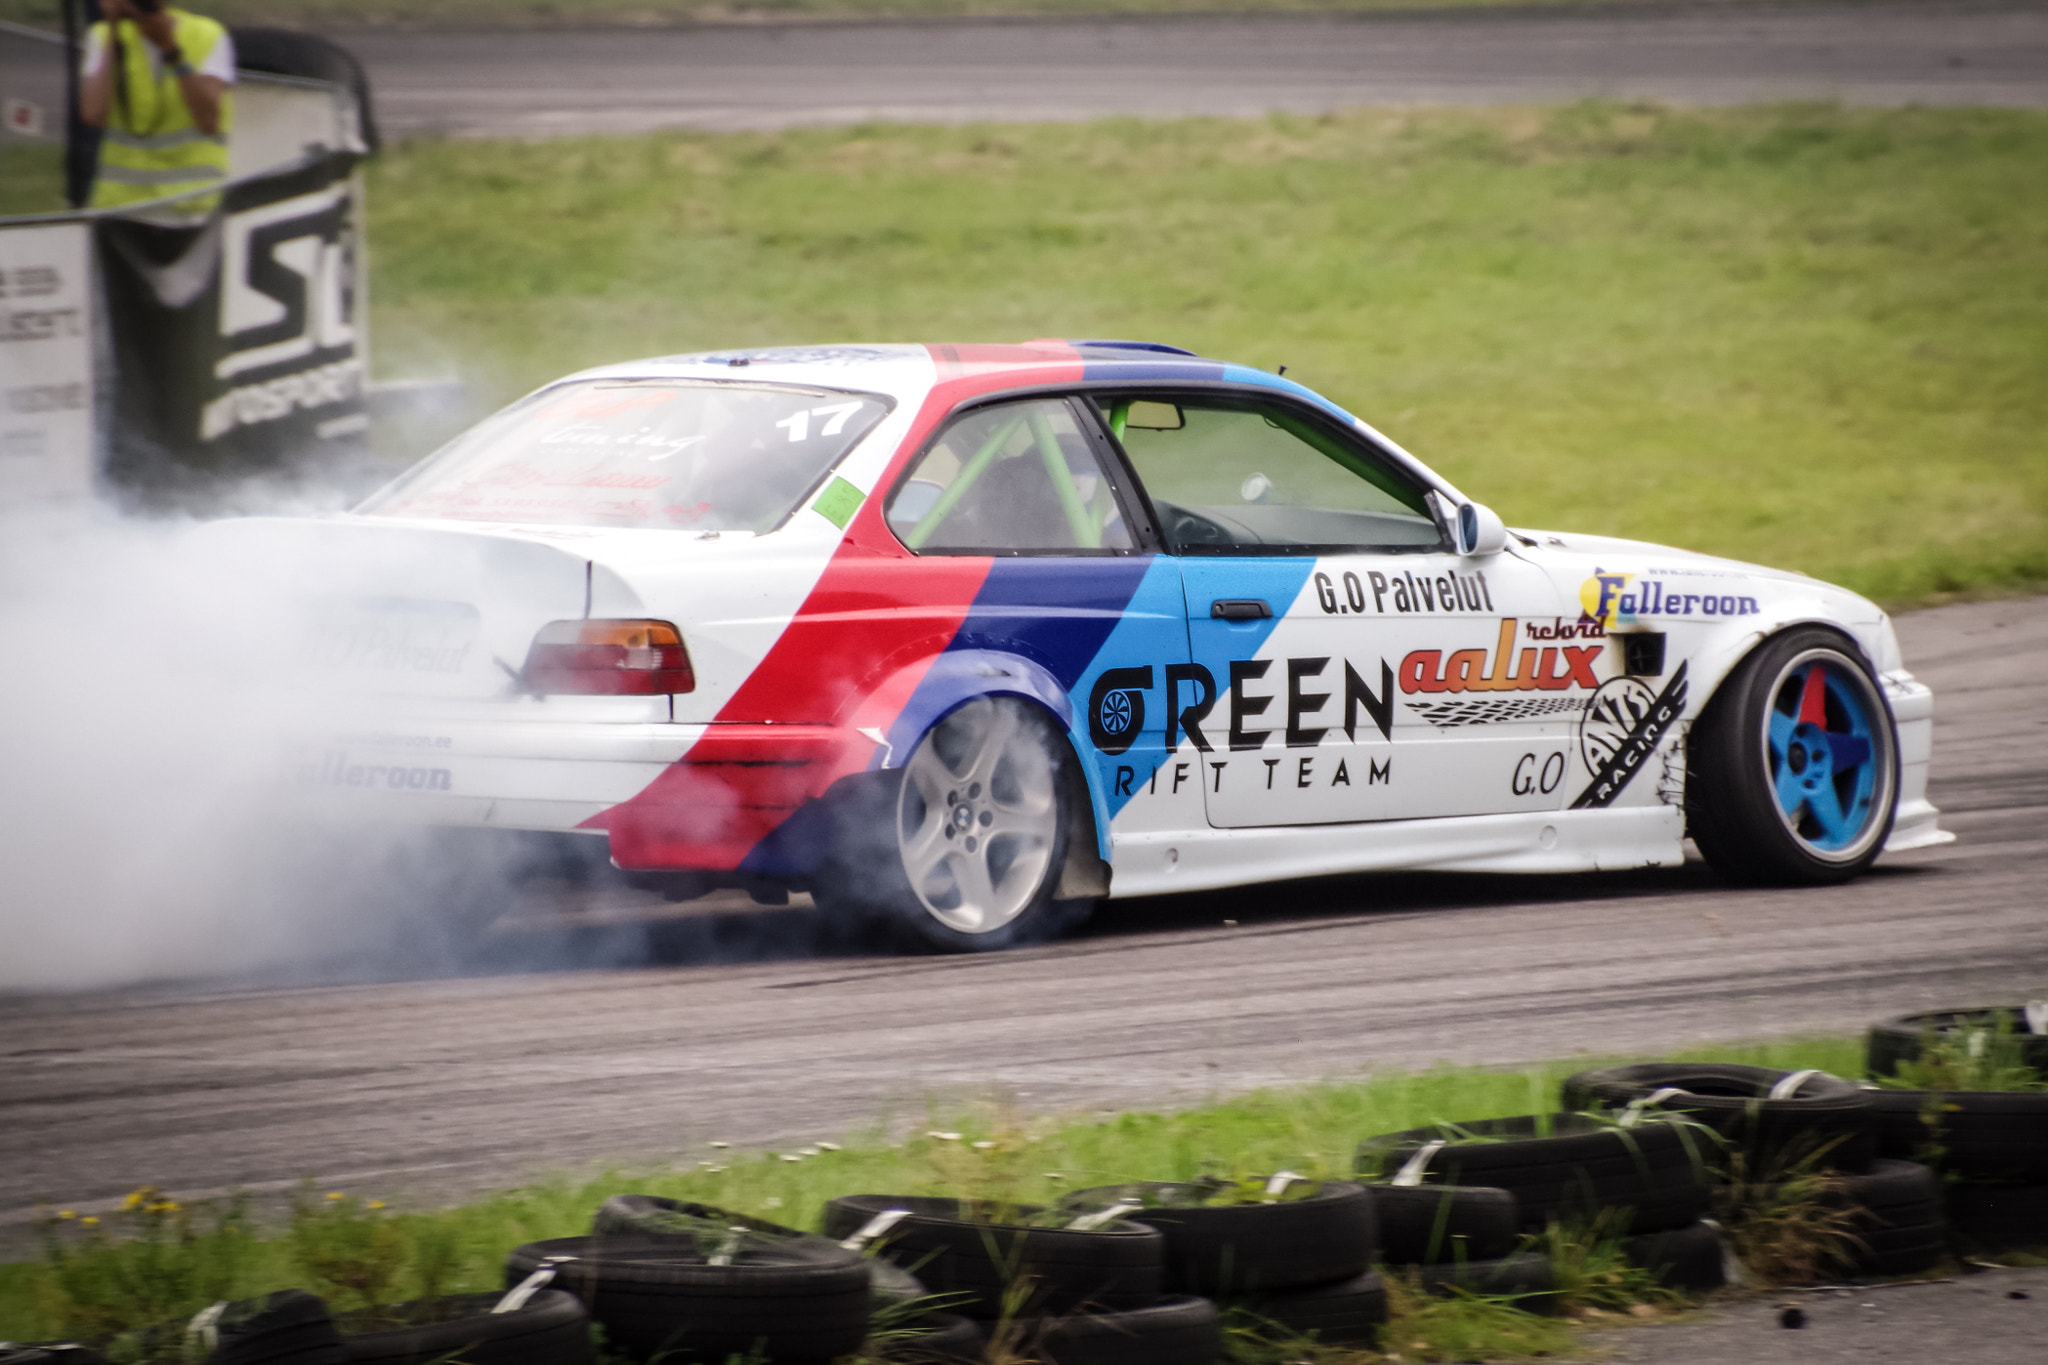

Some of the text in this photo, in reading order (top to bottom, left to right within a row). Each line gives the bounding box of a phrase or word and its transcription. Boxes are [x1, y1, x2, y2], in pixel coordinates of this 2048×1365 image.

[776, 402, 863, 442] 17
[1314, 569, 1494, 615] G.O Palvelut
[1594, 576, 1761, 617] Falleroon
[1399, 617, 1605, 694] aalux
[1263, 756, 1391, 790] TEAM
